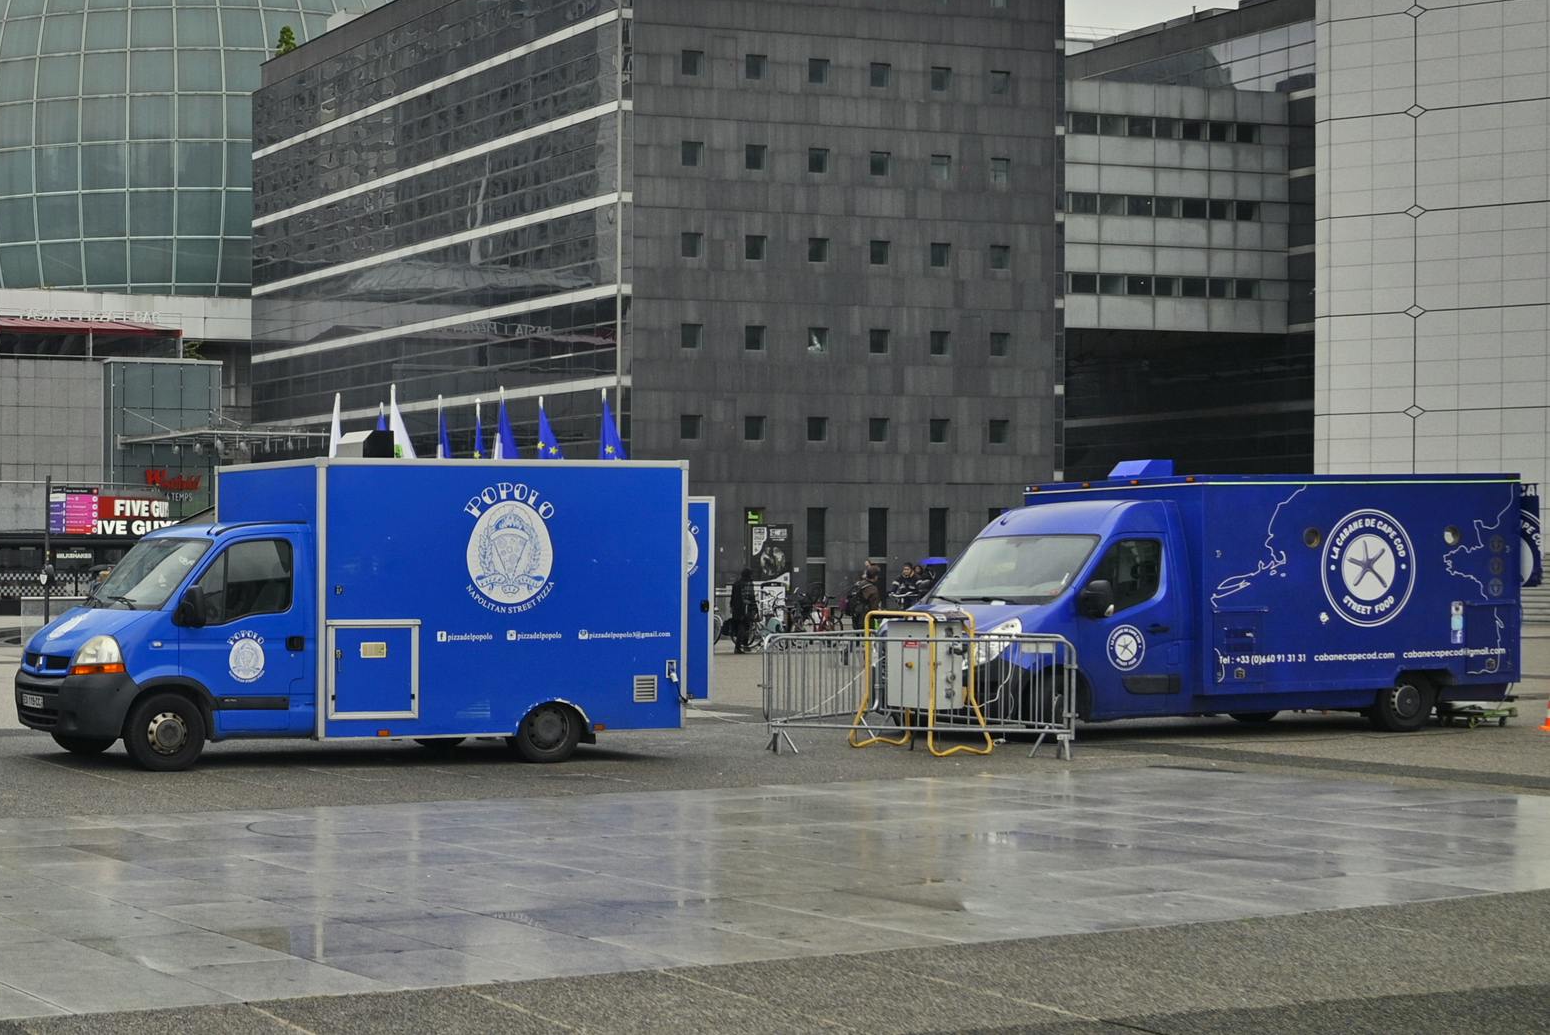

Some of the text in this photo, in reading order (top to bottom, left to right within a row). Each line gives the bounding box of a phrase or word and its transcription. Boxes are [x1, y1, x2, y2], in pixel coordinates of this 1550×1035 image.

[171, 492, 193, 502] TEMPS
[463, 482, 555, 519] POPOLO
[114, 499, 149, 517] FIVE
[1330, 518, 1407, 560] LA CABANE DE CAPE COD
[465, 583, 506, 614] NAPOLITAN
[507, 600, 537, 615] STREET
[536, 580, 555, 603] PIZZA
[1342, 595, 1395, 615] STREET FOOD
[226, 629, 265, 645] POPOLO
[447, 632, 493, 642] pizzadelpopolo
[517, 631, 562, 641] pizzadelpopolo
[1219, 655, 1231, 665] Tel
[1235, 655, 1250, 664] +33
[1251, 654, 1276, 665] (0)660
[1277, 654, 1286, 663] 91
[1287, 654, 1296, 663] 31
[1297, 654, 1307, 663] 31
[1314, 651, 1396, 662] cabanecapecod.com
